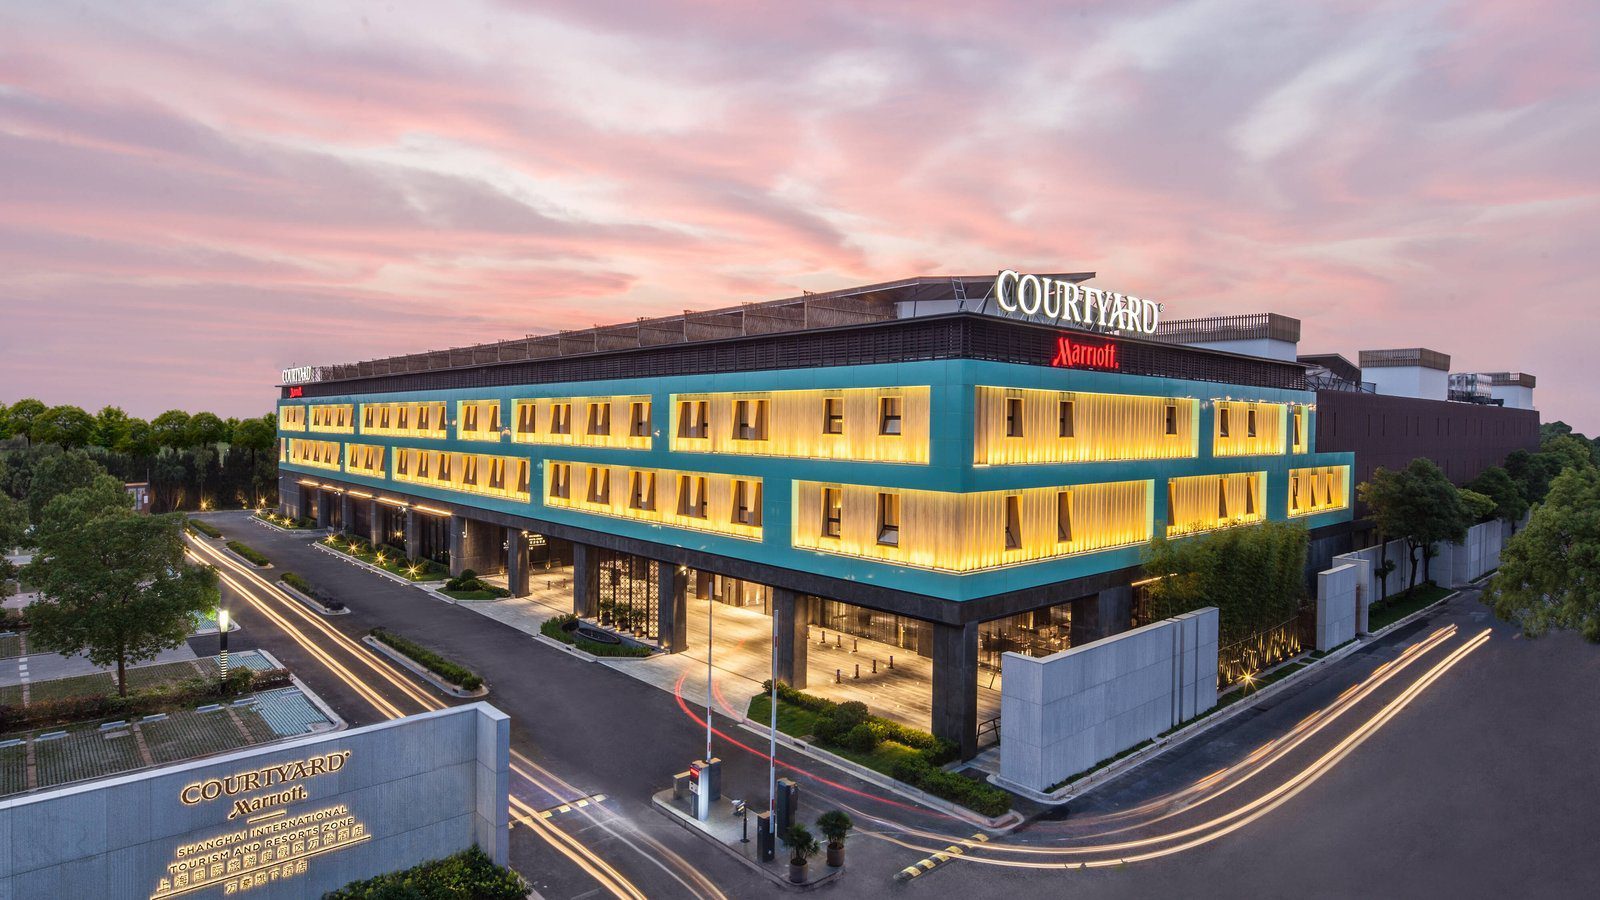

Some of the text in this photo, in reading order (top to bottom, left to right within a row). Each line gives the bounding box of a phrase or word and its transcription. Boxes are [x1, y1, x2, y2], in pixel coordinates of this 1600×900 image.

[996, 269, 1159, 334] COURTYARD
[181, 752, 346, 804] COURTYARD
[157, 826, 363, 892] 上海国际旅游度假区万怡酒店
[170, 817, 354, 874] TOURISM AND RESORTS ZONE
[178, 807, 347, 857] SHANGHAI INTERNATIONAL
